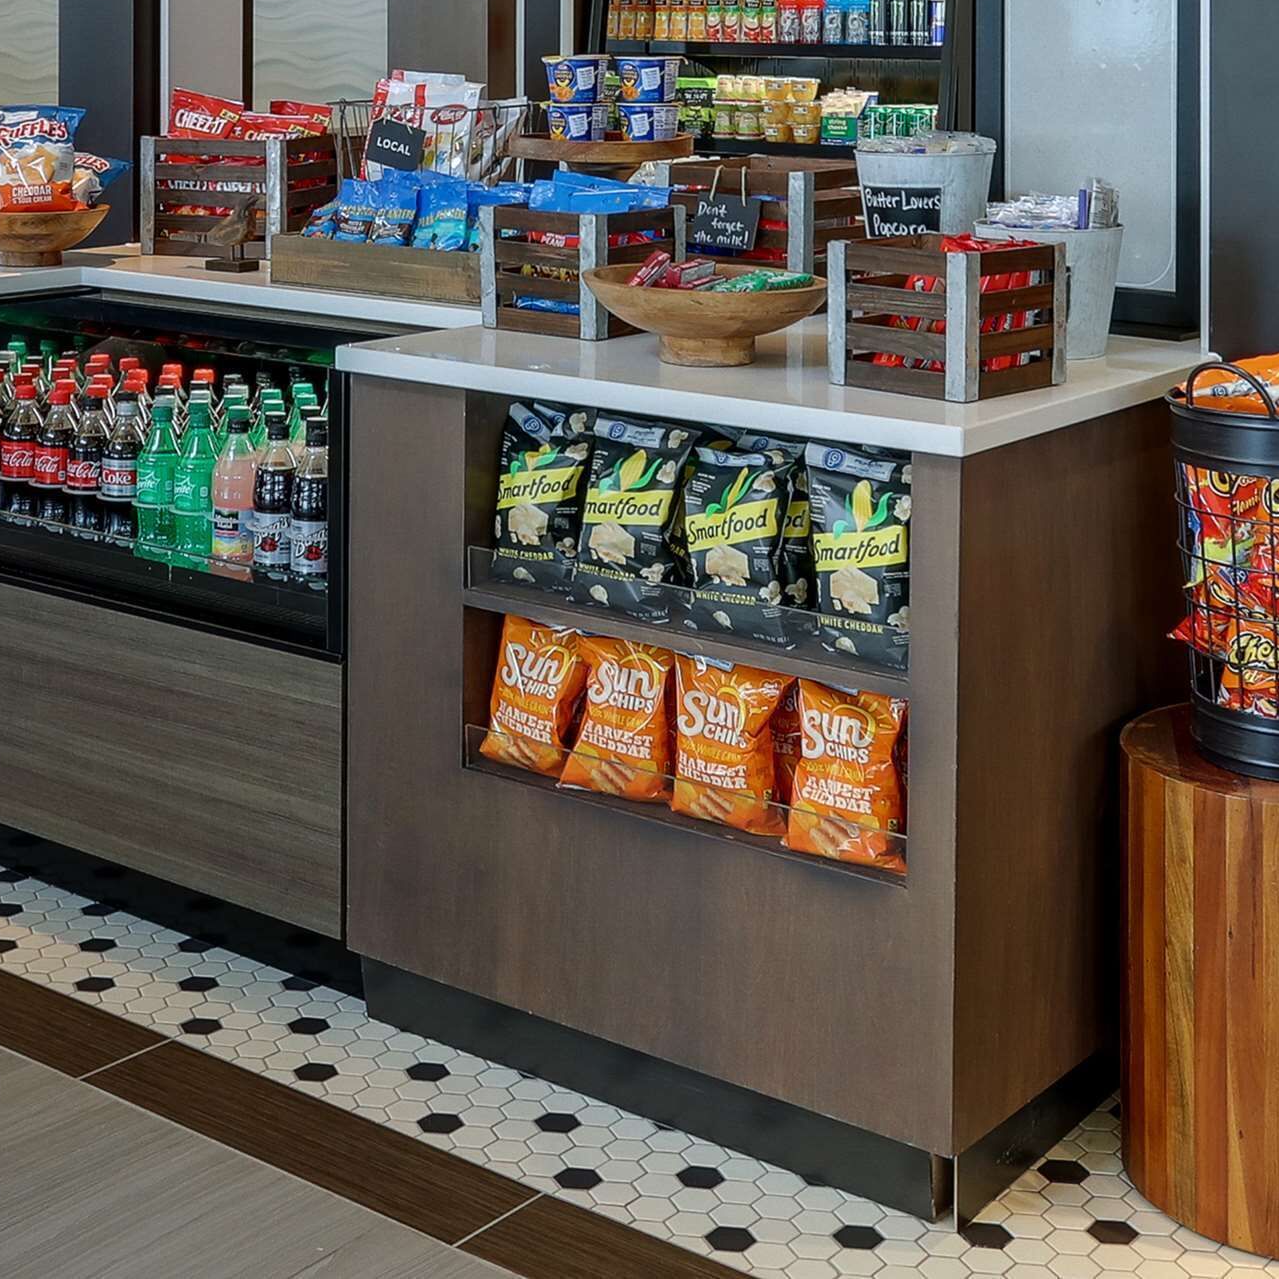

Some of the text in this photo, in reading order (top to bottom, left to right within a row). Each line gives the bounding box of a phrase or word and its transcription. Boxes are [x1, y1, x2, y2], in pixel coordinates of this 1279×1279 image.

[175, 108, 228, 135] CHEEZ-IT
[376, 136, 412, 157] LOCAL
[698, 201, 728, 218] Don't
[865, 188, 941, 210] Butter Lovers
[711, 217, 745, 234] forget
[873, 214, 927, 237] Popcorn
[694, 230, 749, 249] the milk!
[102, 469, 132, 485] Coke
[497, 473, 575, 501] Smartfood
[586, 496, 664, 519] martfood
[687, 508, 768, 545] Smartfood
[520, 549, 554, 560] CHEDDAR
[814, 532, 901, 563] Smartfood
[720, 592, 757, 606] CHEDDAR
[844, 620, 884, 634] CHEDDAR
[501, 643, 566, 687] Sun
[515, 677, 558, 700] CHIPS
[588, 660, 658, 705] Sun
[608, 693, 654, 714] CHIPS
[677, 690, 742, 737] Sun
[496, 711, 553, 744] CHEDDAR
[499, 700, 555, 732] HARVEST
[584, 720, 653, 744] HARVEST
[801, 709, 873, 759] Sun
[581, 731, 651, 759] CHEDDAR
[825, 742, 870, 764] CHIPS
[679, 750, 747, 776] HARVEST
[679, 762, 747, 789] CHEDDAR
[801, 786, 872, 815] CHEDDAR
